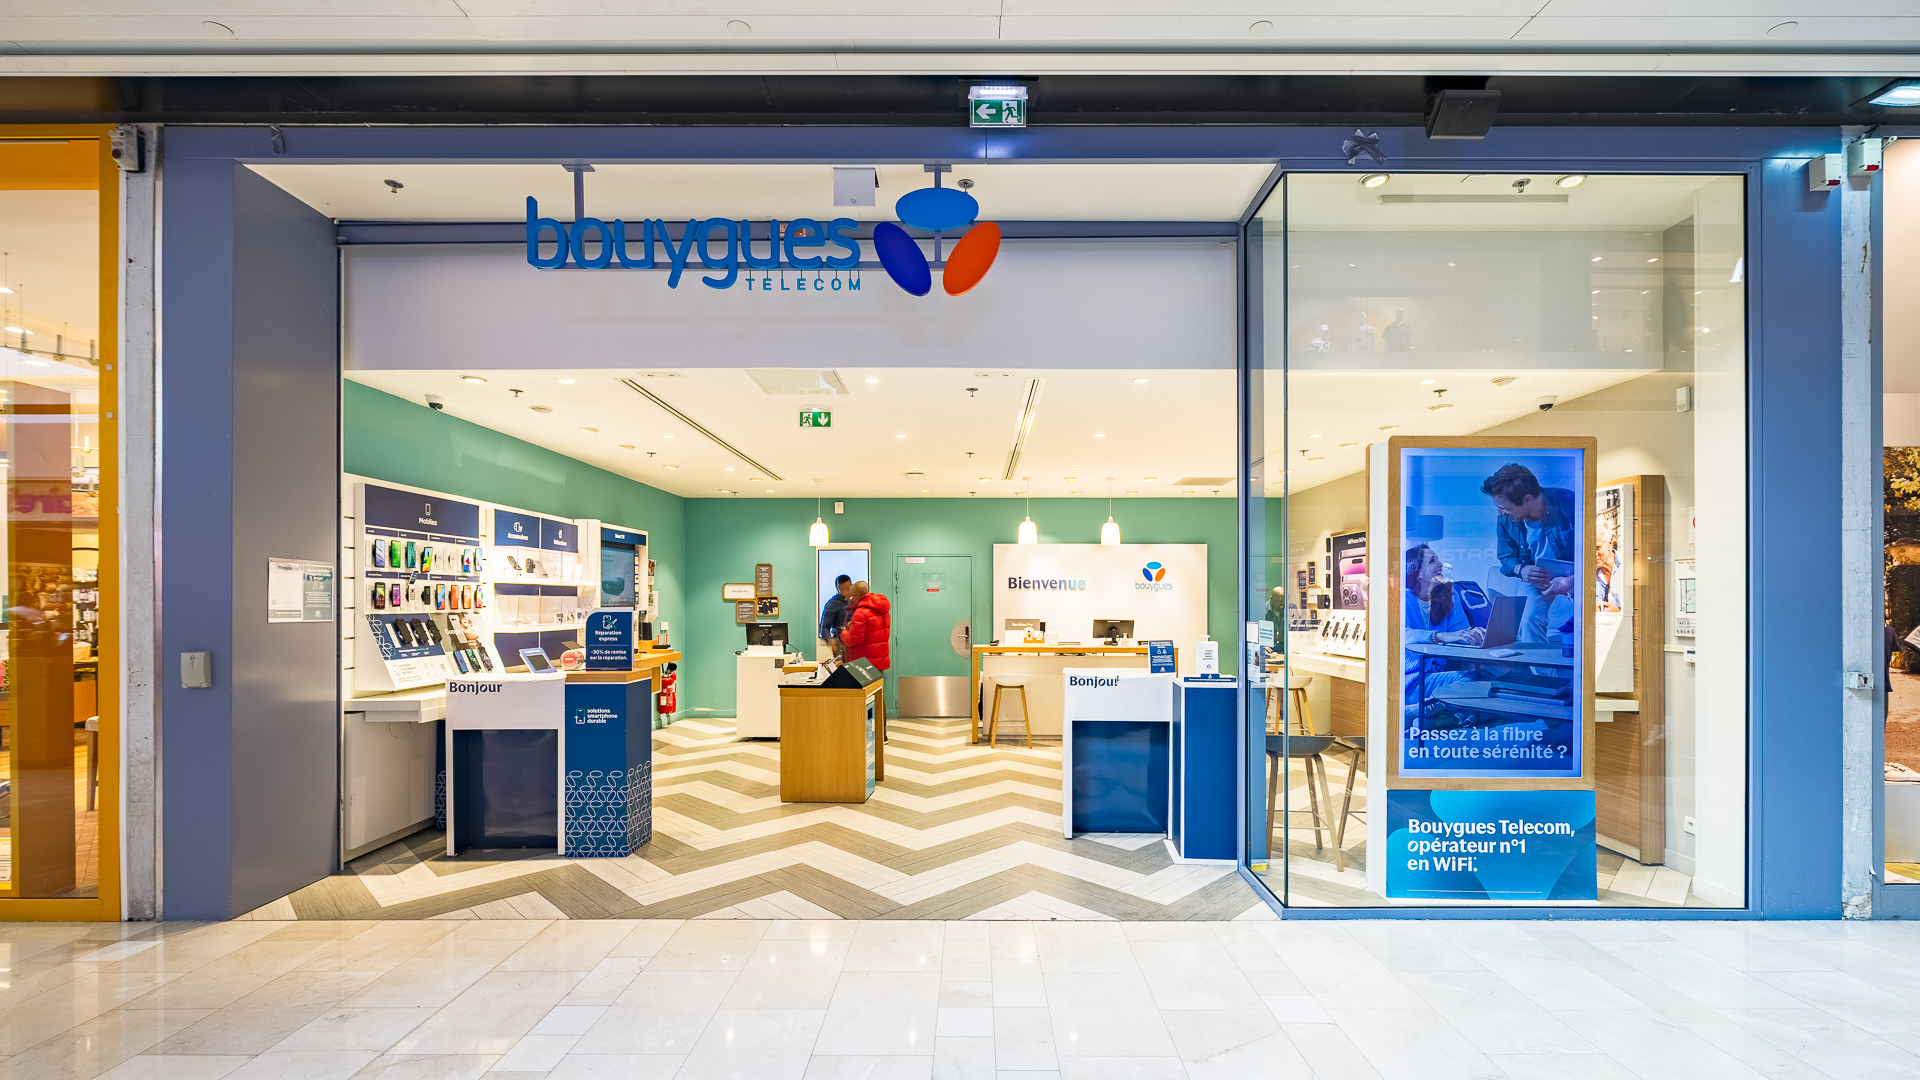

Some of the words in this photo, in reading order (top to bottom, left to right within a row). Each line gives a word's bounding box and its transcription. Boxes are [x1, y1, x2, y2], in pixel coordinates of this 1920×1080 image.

[526, 195, 861, 289] bouygues
[745, 278, 861, 290] TELECOM
[418, 517, 438, 526] Mobiles
[1008, 576, 1086, 590] Bienvenue
[1135, 581, 1173, 592] bouygues
[449, 681, 502, 695] Bonjour
[1410, 727, 1467, 741] Passez
[1471, 727, 1480, 741] à
[1485, 727, 1498, 741] la
[1502, 727, 1543, 741] fibre
[1409, 747, 1429, 758] en
[1434, 746, 1479, 758] toute
[1482, 745, 1553, 758] sérénité
[1557, 746, 1567, 758] ?
[1408, 819, 1495, 837] Bouygues
[1499, 819, 1575, 837] Telecom,
[1407, 838, 1496, 855] opérateur
[1500, 839, 1526, 853] n°1
[1407, 860, 1429, 870] en
